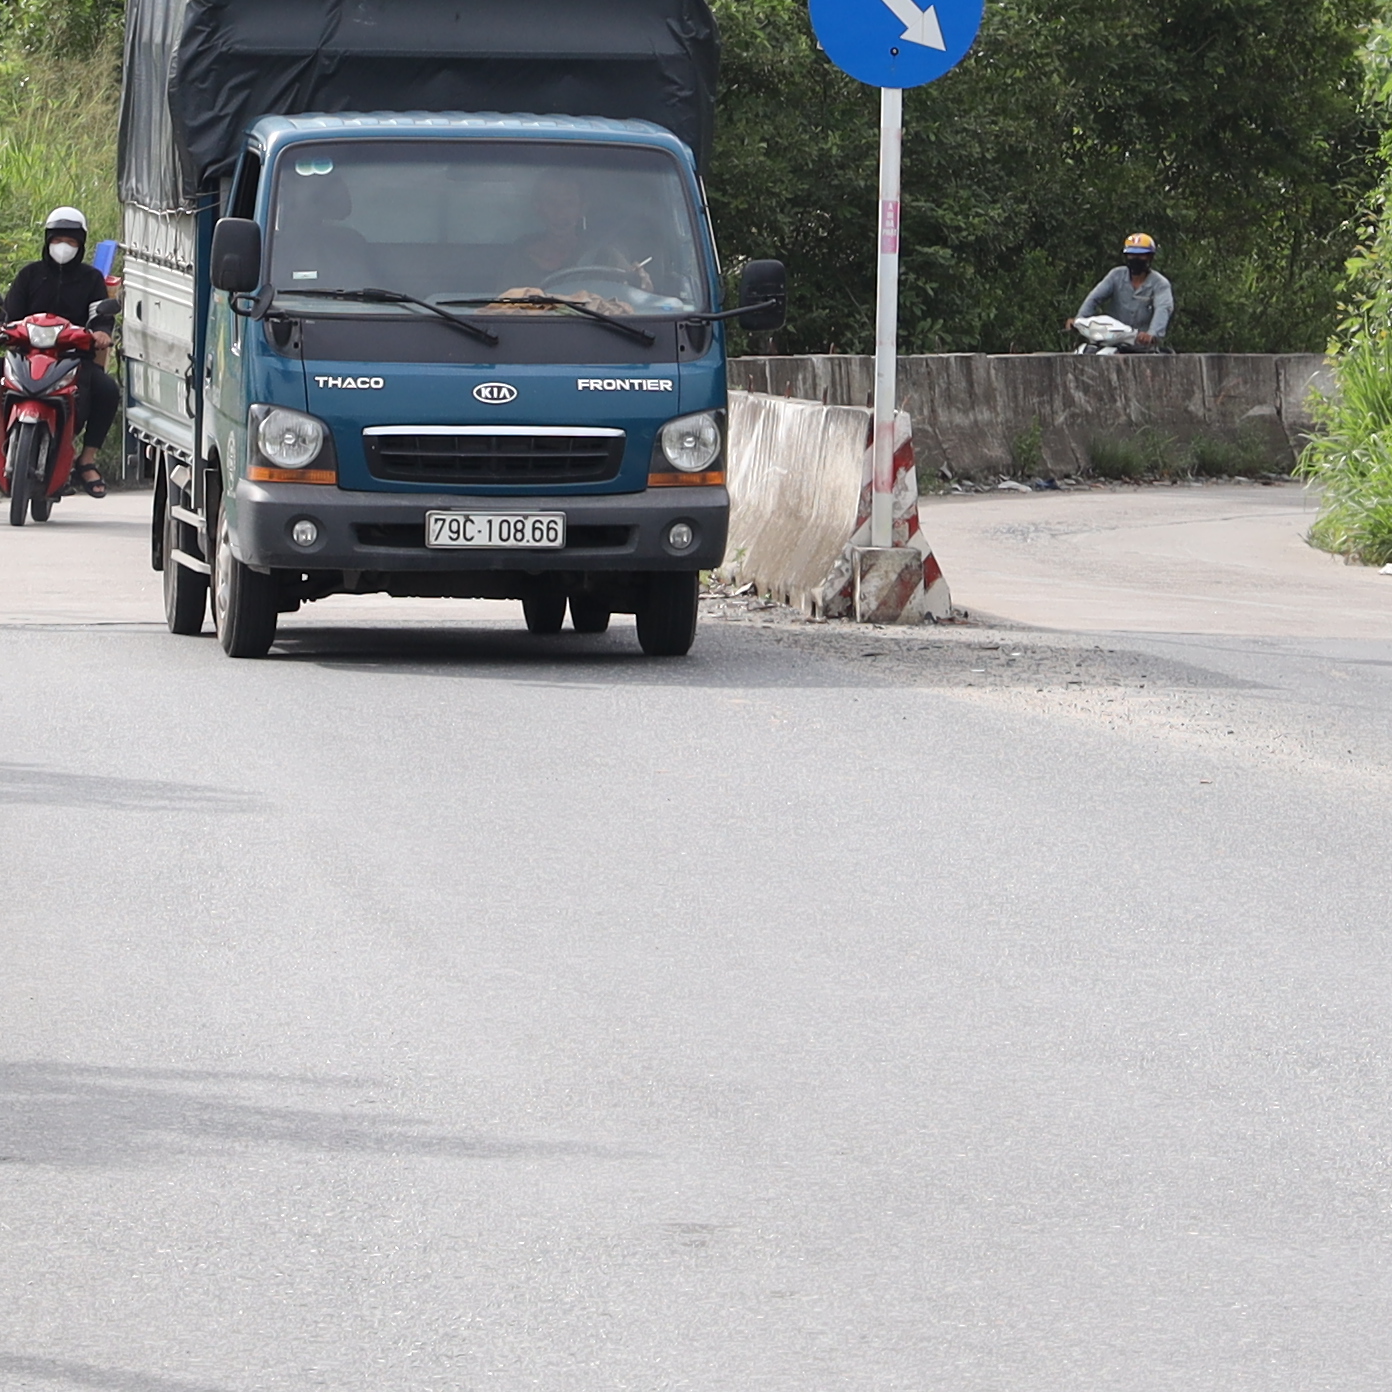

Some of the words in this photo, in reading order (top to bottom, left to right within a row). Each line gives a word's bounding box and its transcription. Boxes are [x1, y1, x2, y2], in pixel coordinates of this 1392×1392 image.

[314, 376, 385, 389] THACO
[577, 379, 673, 391] FRONTIER
[480, 387, 511, 399] KIA
[433, 517, 559, 544] 79C-108.66
